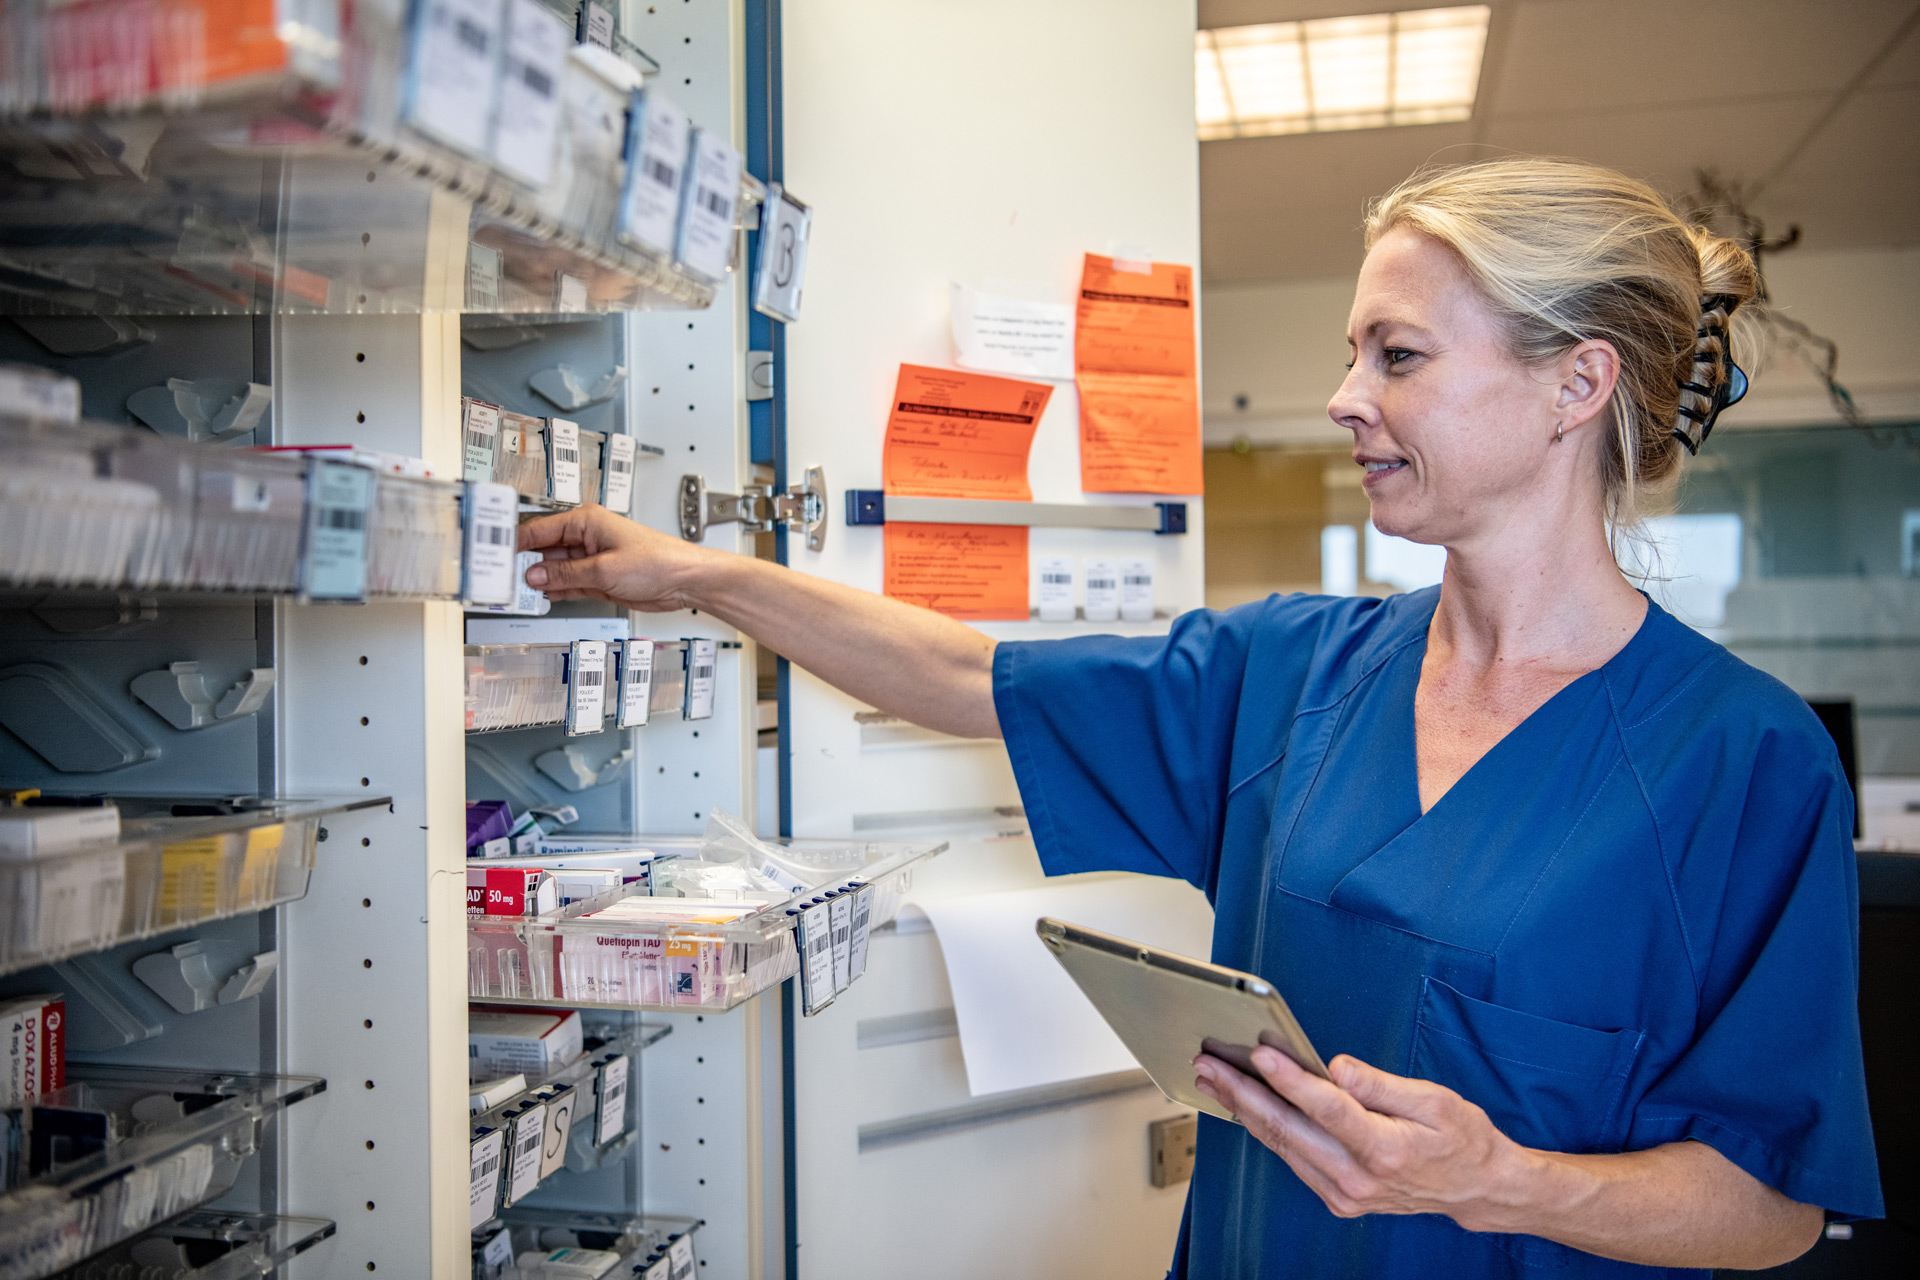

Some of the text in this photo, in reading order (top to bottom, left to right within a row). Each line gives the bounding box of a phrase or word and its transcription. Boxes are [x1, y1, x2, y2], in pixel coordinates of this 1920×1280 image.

[489, 890, 502, 903] 50
[503, 896, 514, 906] mg
[597, 936, 640, 950] Quetiapin
[669, 938, 692, 952] 25 mg
[12, 1022, 22, 1033] 4
[10, 1036, 19, 1056] mg
[50, 1032, 58, 1065] ALIUD
[547, 1106, 568, 1159] S
